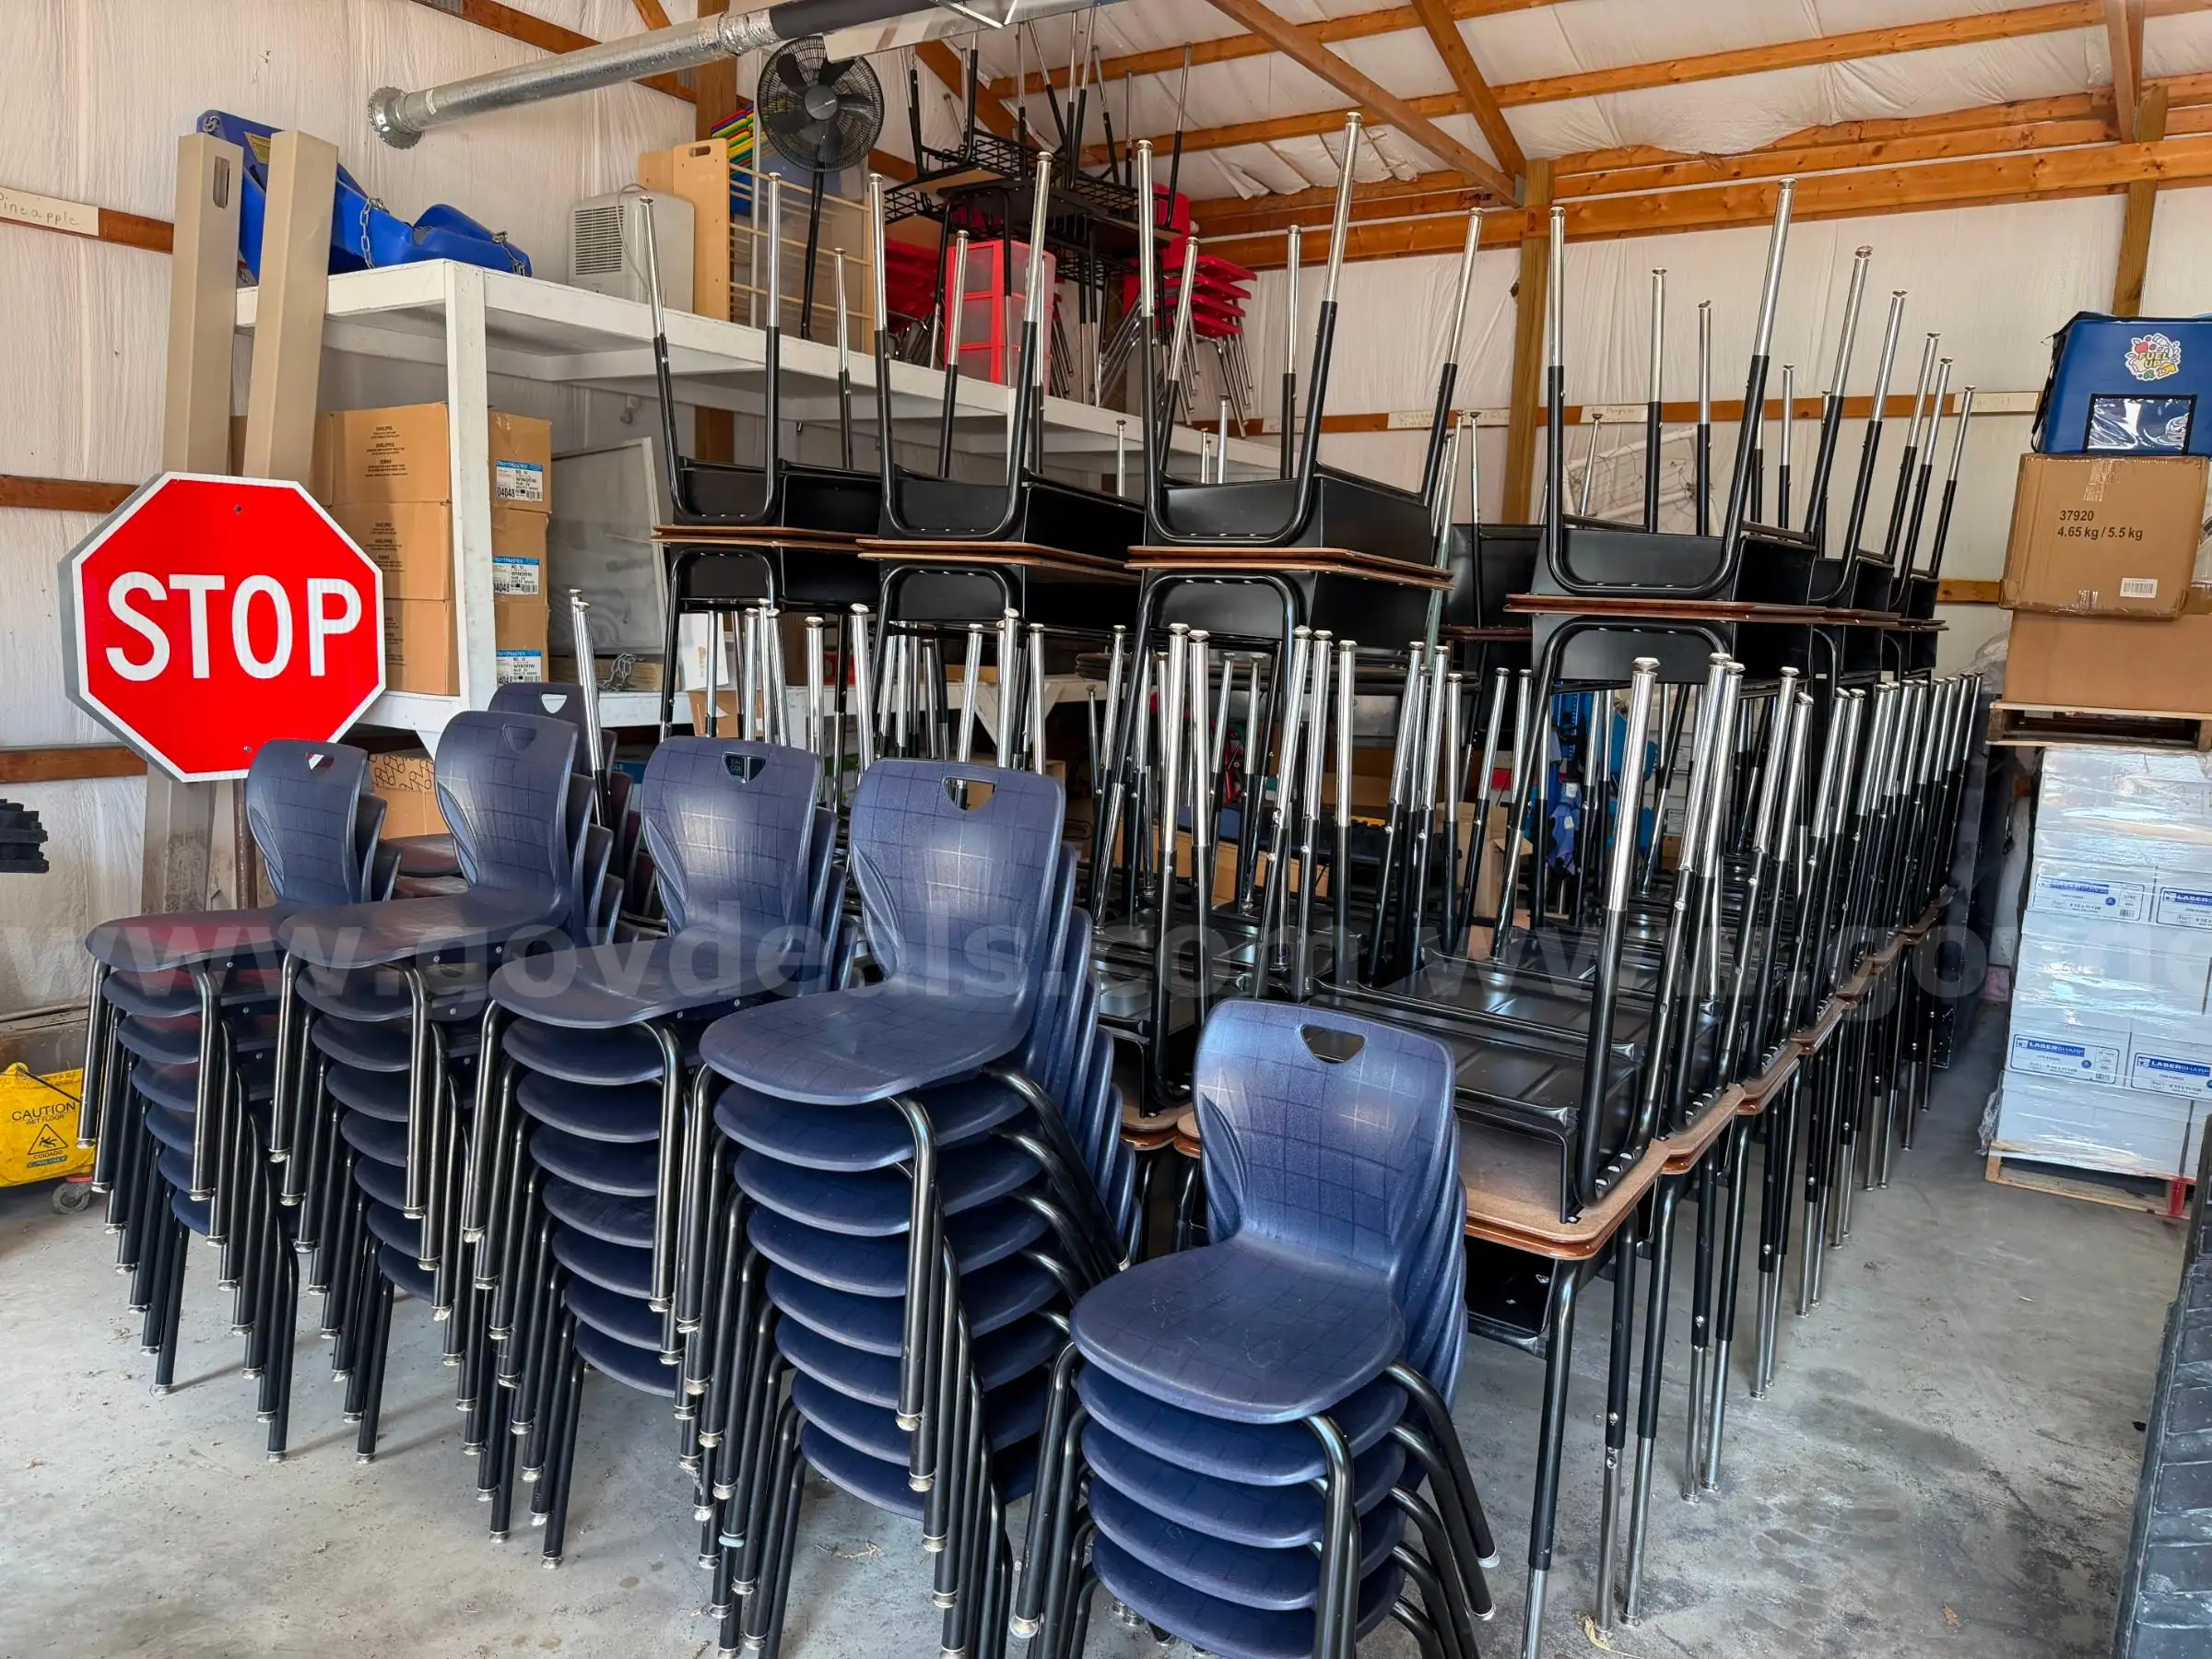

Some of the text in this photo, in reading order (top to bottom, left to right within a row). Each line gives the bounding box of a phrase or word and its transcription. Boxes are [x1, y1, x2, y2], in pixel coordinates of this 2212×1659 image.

[2138, 351, 2169, 360] FUEL
[2144, 359, 2162, 368] UP
[2059, 510, 2095, 522] 37920
[2057, 526, 2143, 541] 4.65 kg / 5.5 kg
[106, 571, 362, 681] STOP
[2029, 1041, 2085, 1055] LASERSHARP
[2151, 1059, 2210, 1075] LASERSHARP
[12, 1102, 76, 1121] CAUTION
[42, 1114, 65, 1123] FLOOR
[33, 1149, 64, 1159] CUIDADO
